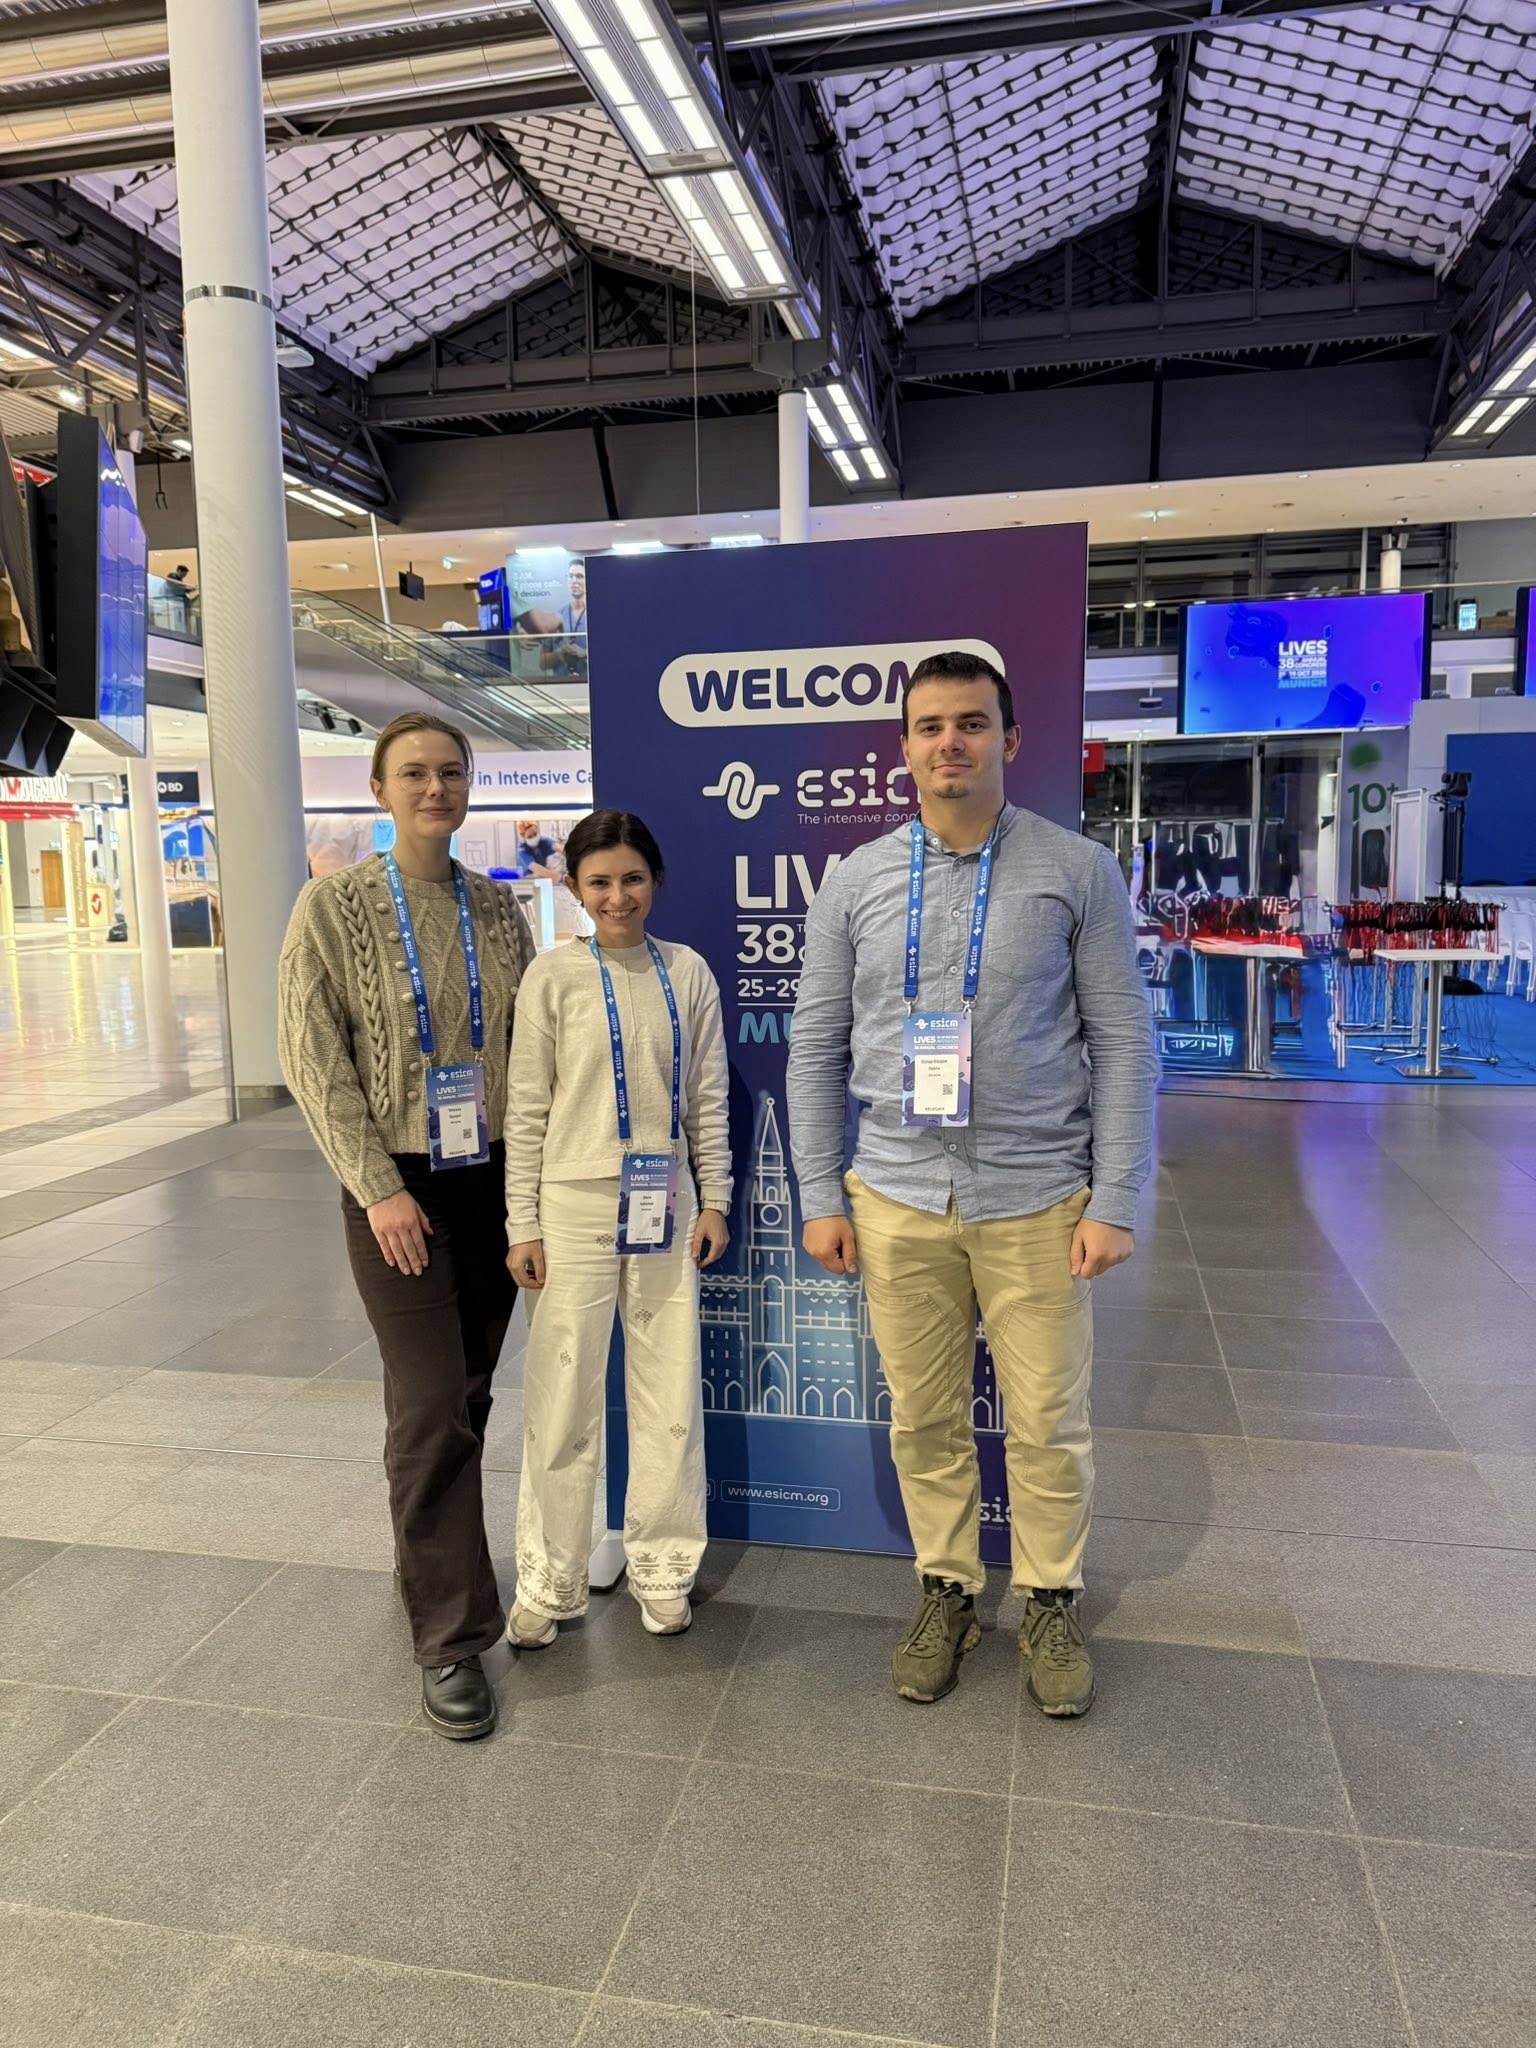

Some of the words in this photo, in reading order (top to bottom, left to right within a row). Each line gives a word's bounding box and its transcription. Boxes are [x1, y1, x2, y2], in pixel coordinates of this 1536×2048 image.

[1279, 640, 1328, 655] LIVES
[1280, 658, 1294, 669] 38
[478, 771, 492, 785] in
[498, 769, 570, 784] Intensive
[168, 782, 183, 792] BD
[797, 813, 820, 825] The
[824, 811, 881, 824] intensive
[736, 923, 796, 964] 38
[970, 945, 978, 965] esicm
[909, 957, 917, 978] esicm
[413, 976, 422, 995] esicm
[419, 1014, 427, 1034] esicm
[931, 1018, 958, 1027] esicm
[450, 1069, 473, 1079] esicm
[437, 1086, 457, 1095] LIVES
[618, 1089, 626, 1108] esicm
[646, 1159, 668, 1168] esicm
[728, 1487, 829, 1506] www.esicm.org
